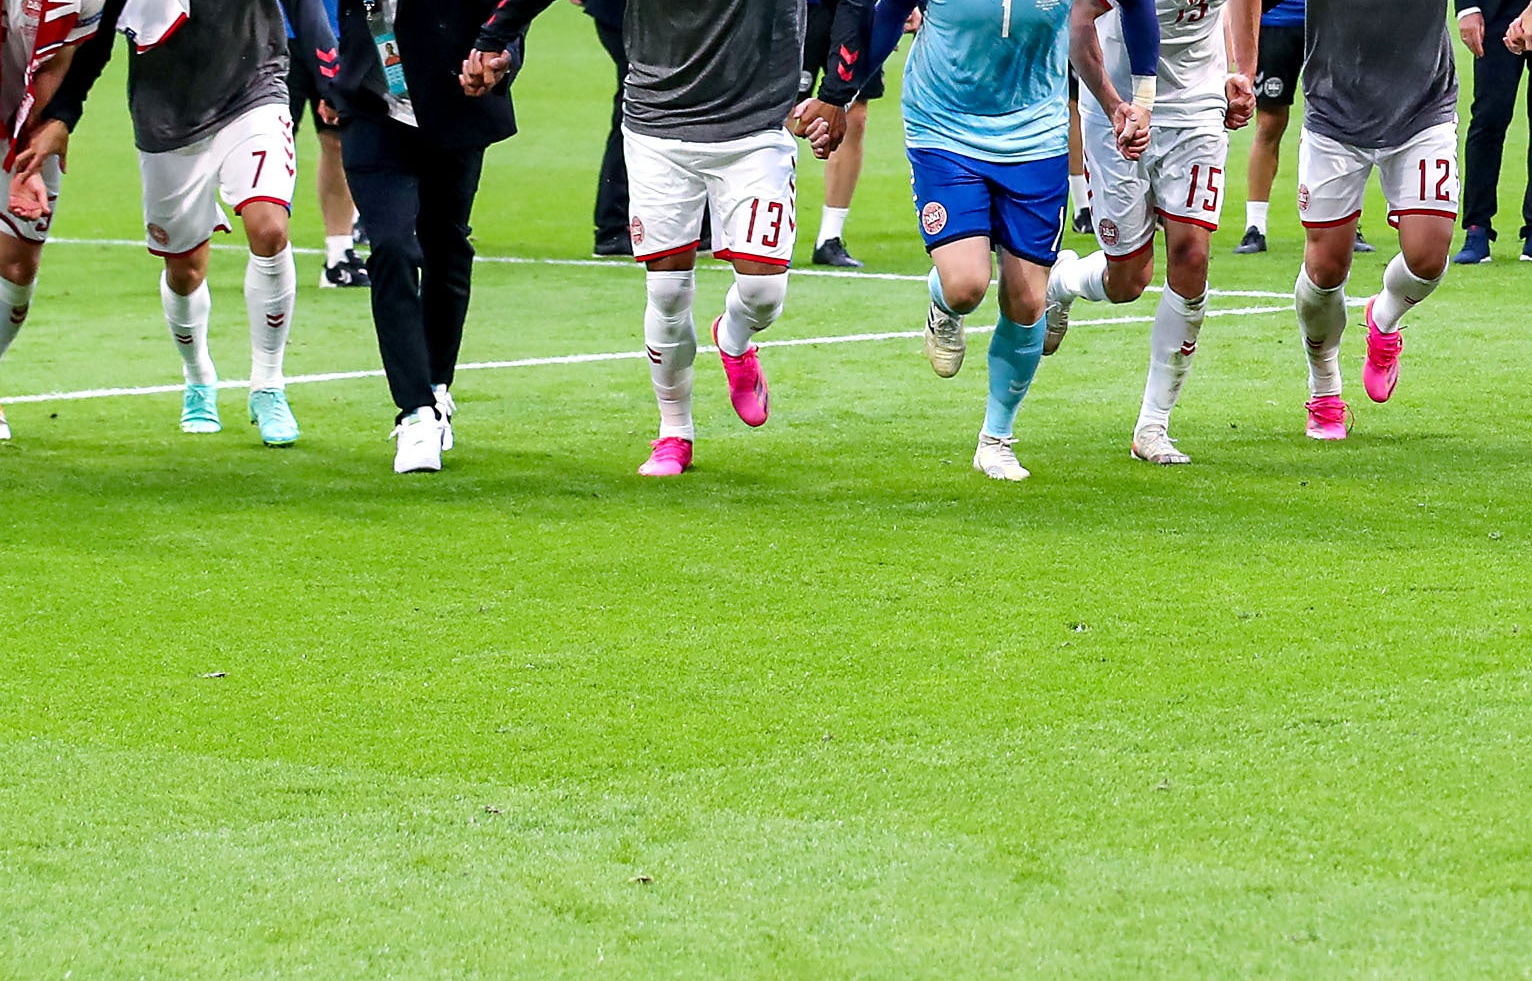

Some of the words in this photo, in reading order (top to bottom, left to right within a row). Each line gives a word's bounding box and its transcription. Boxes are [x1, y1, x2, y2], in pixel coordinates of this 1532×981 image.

[251, 150, 267, 189] 7
[1185, 164, 1222, 213] 15
[1418, 158, 1450, 201] 12
[746, 198, 784, 247] 13
[1050, 206, 1065, 252] 1
